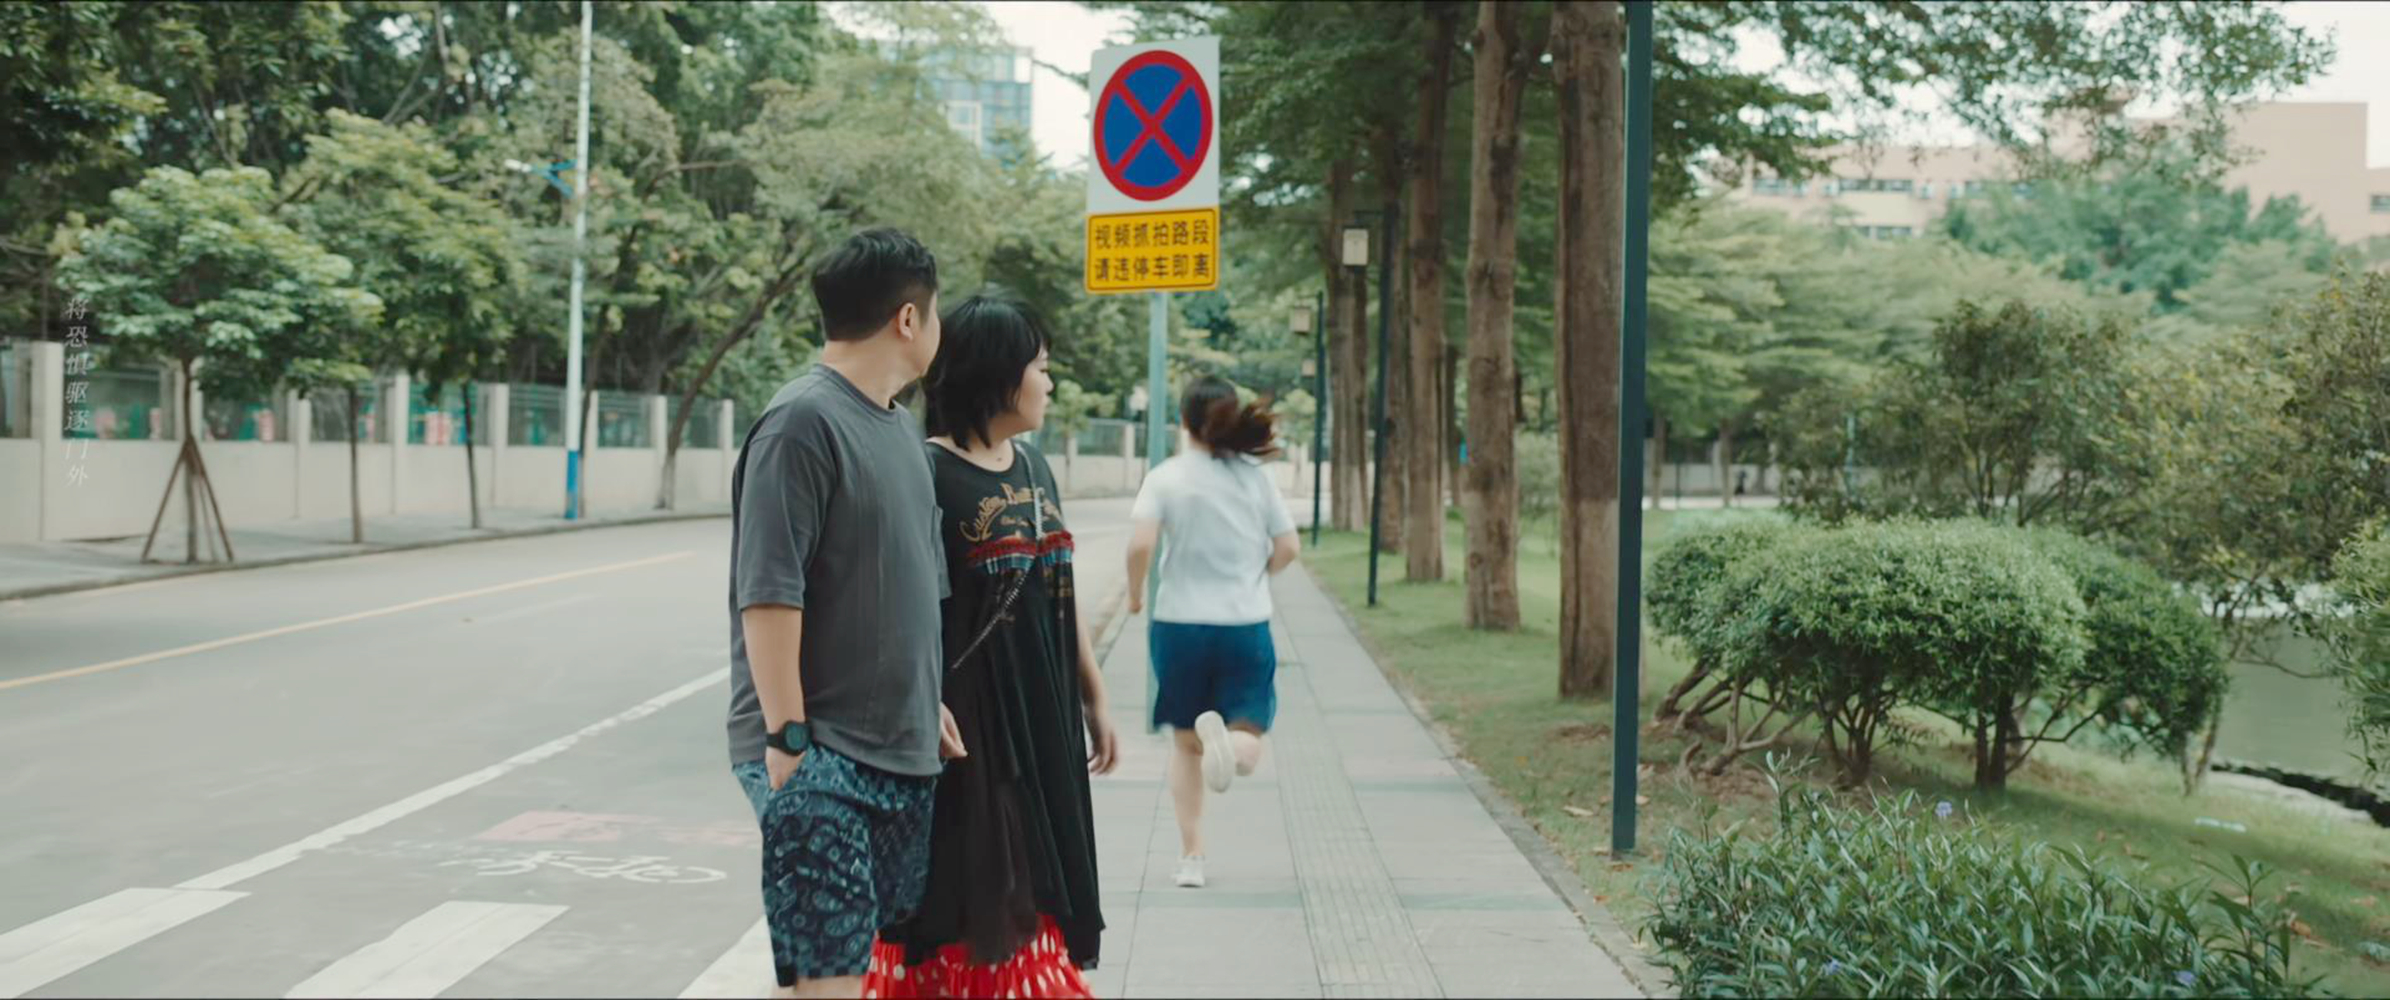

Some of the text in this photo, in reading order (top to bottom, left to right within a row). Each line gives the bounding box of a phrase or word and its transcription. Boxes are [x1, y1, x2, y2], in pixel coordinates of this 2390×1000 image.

[1095, 219, 1209, 249] 视频抓拍路段
[1095, 253, 1210, 281] 请违停车即离
